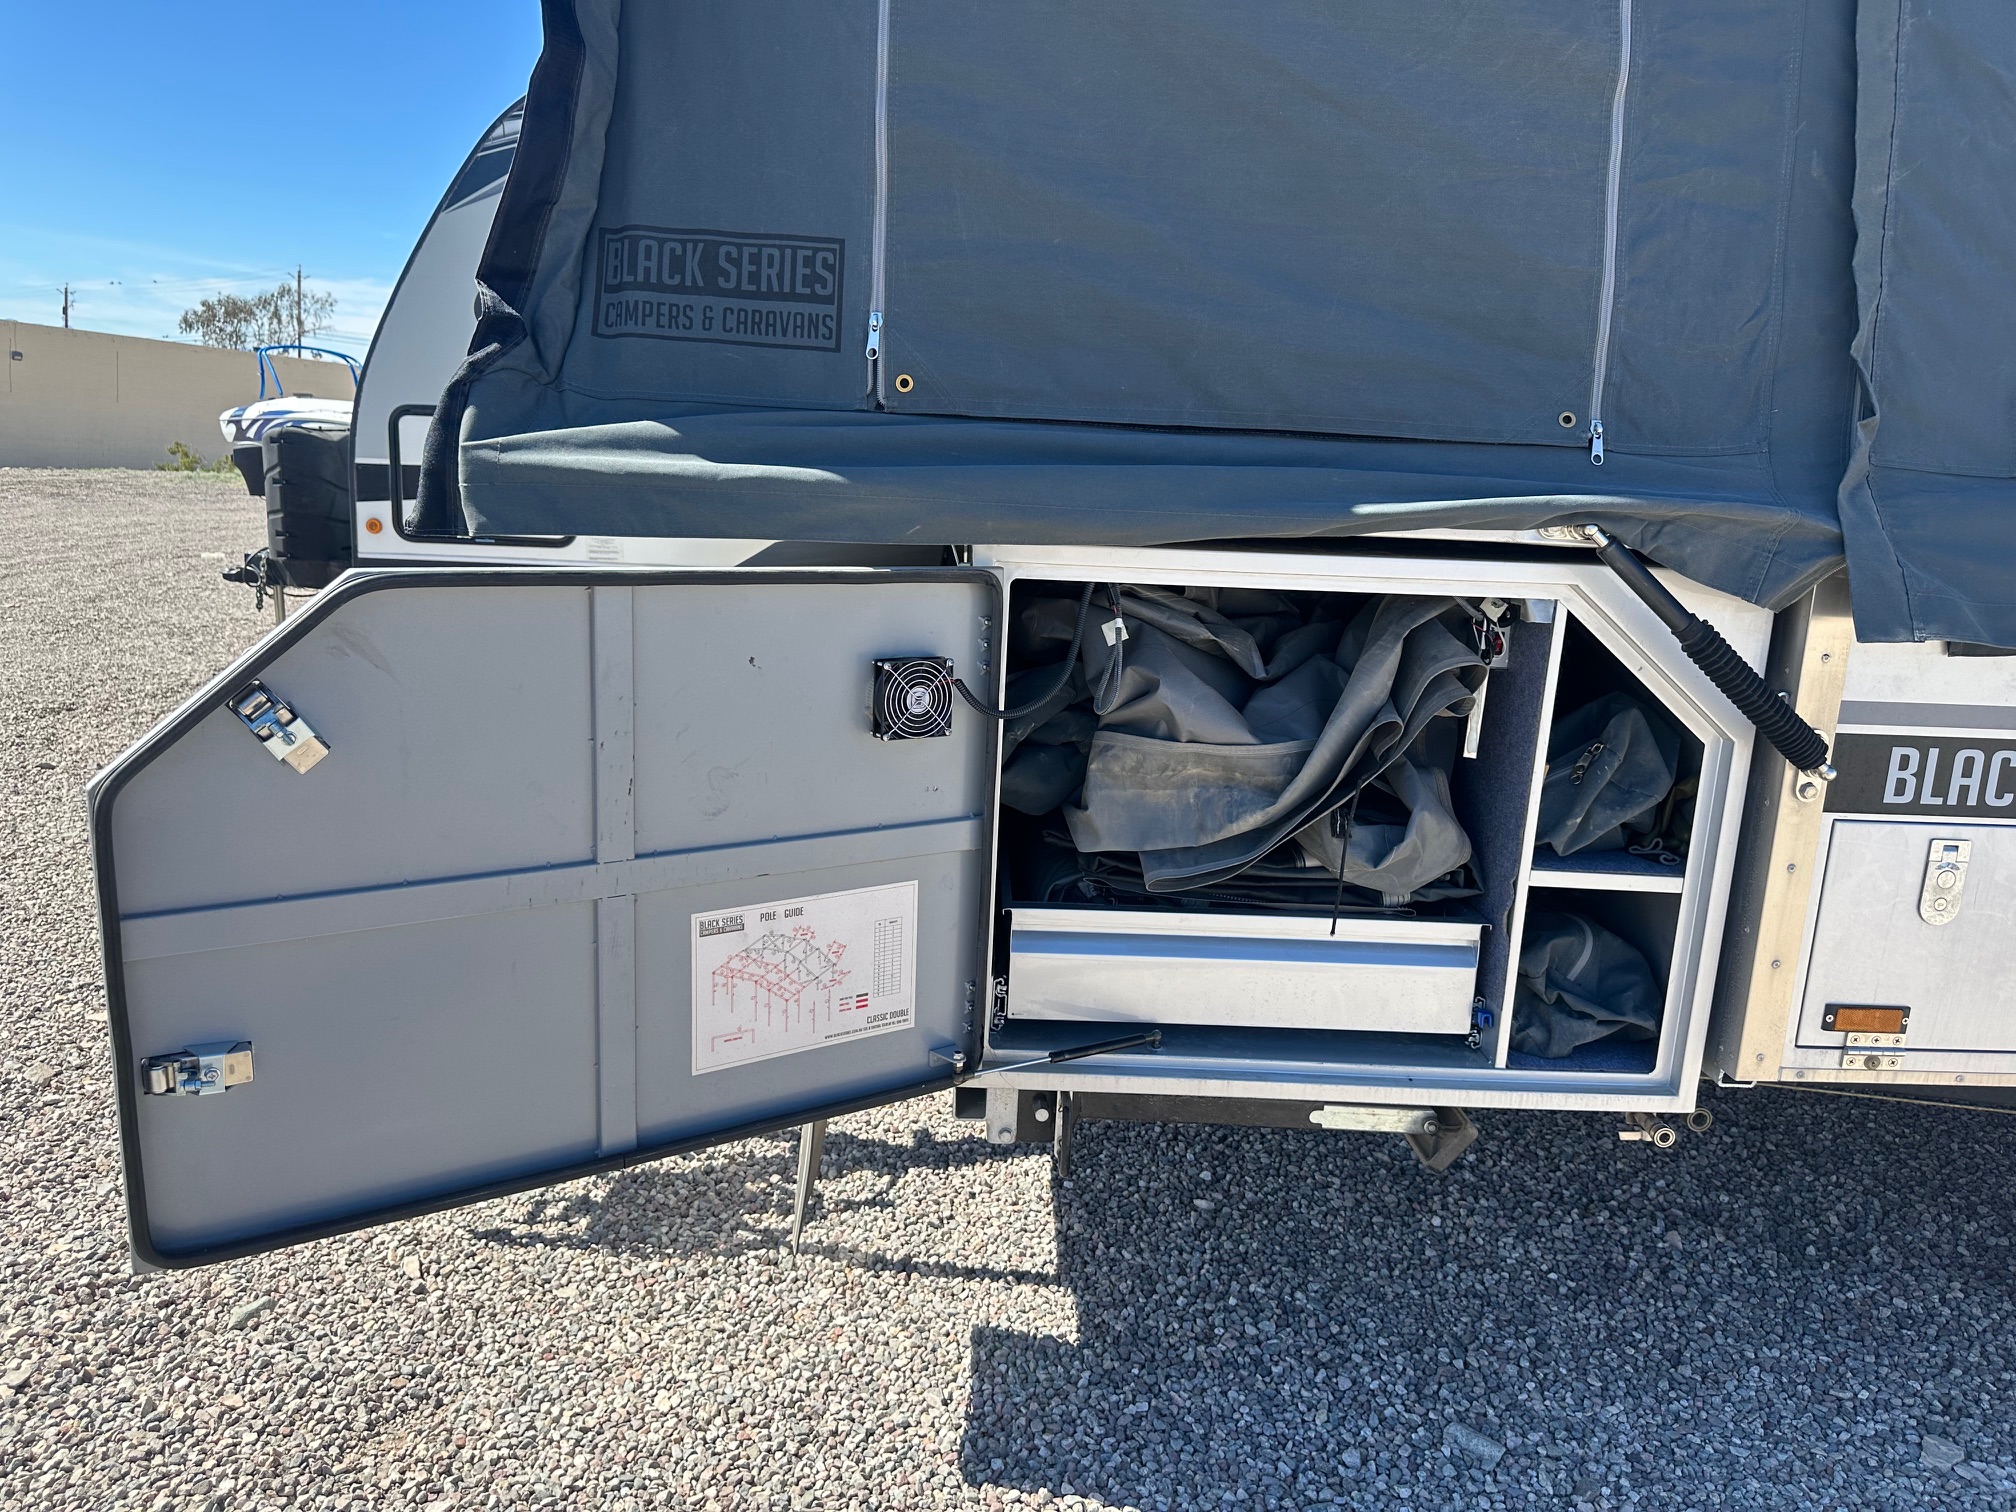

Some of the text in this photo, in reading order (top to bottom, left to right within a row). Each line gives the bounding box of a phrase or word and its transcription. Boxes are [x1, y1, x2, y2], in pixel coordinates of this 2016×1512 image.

[606, 238, 835, 296] BLACK SERIES
[604, 299, 834, 341] CAMPERS & CARAVANS
[700, 914, 744, 930] BLACK SERIES
[760, 906, 804, 923] POLE GUIDE
[866, 1007, 910, 1024] CLASSIC DOUBLE
